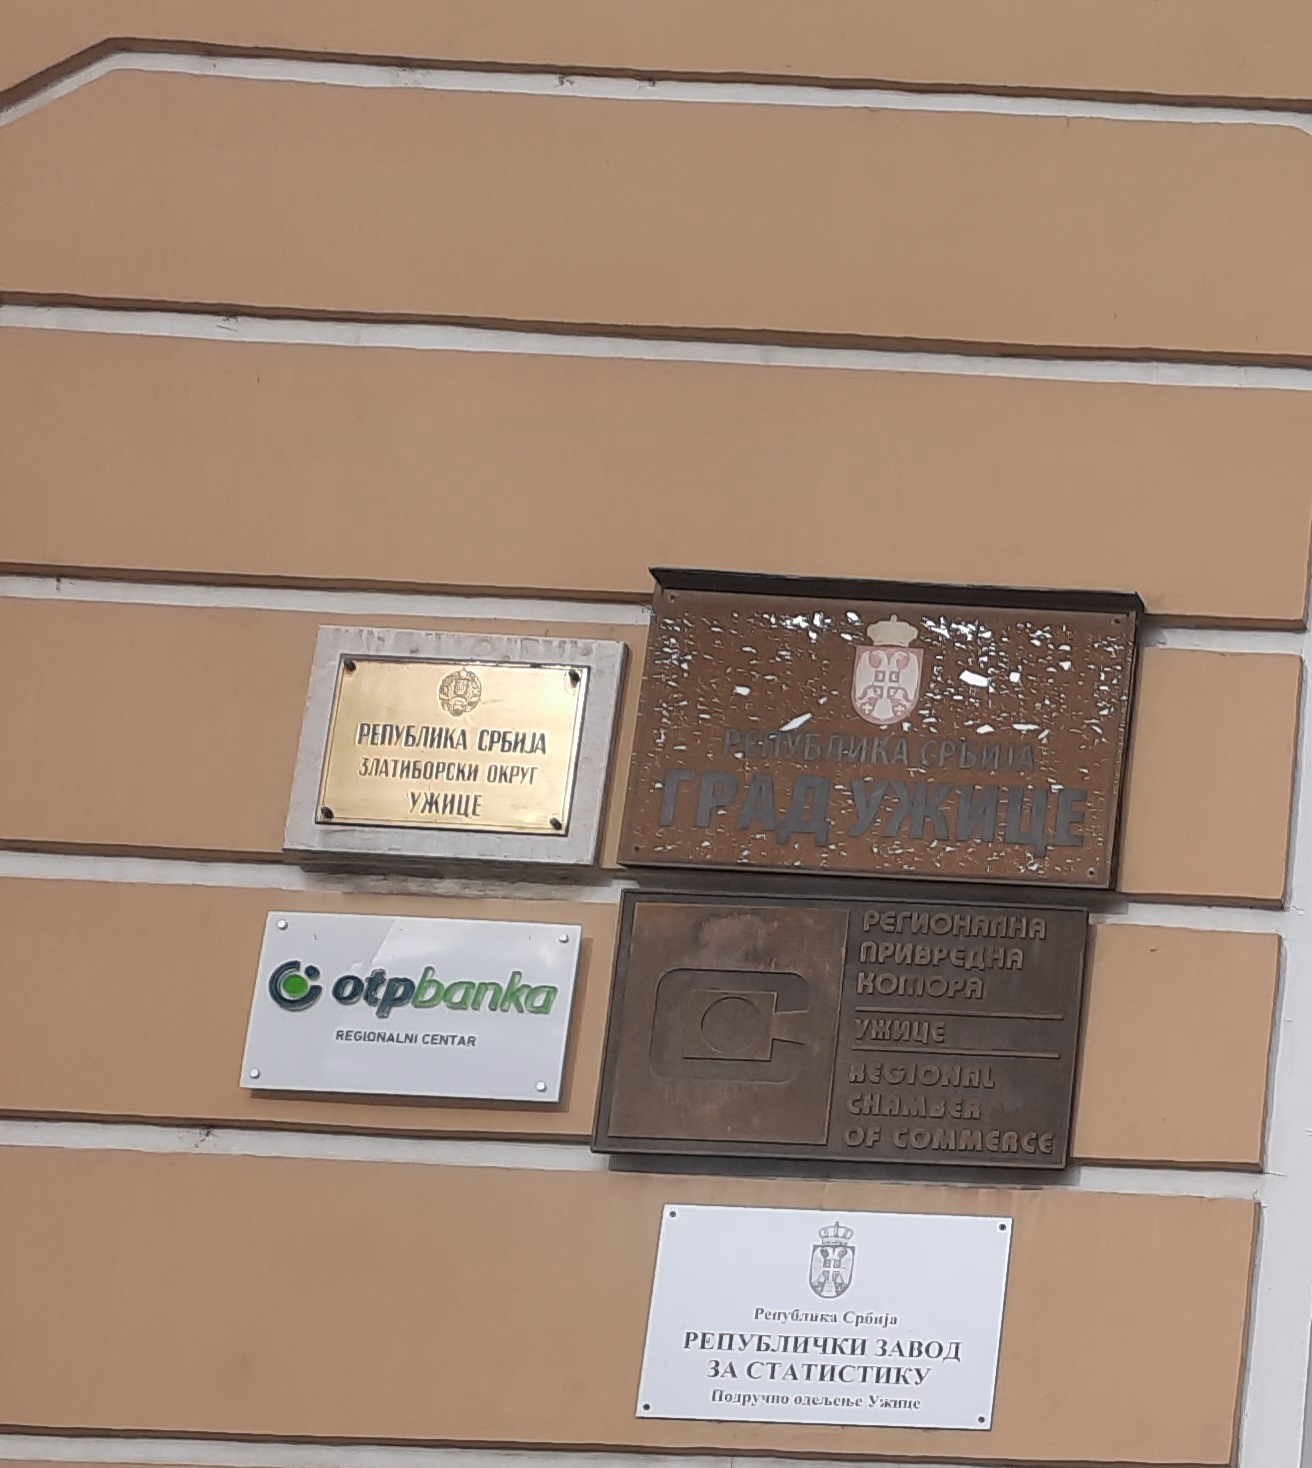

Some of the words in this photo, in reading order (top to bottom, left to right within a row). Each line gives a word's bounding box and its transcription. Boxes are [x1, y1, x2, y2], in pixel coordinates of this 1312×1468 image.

[357, 723, 467, 750] РЕПУБЛИКА
[478, 729, 546, 754] СРБИЈА
[723, 728, 909, 765] РЕПУБЛИКА
[920, 740, 1034, 770] СРБИЈА
[358, 757, 478, 783] ЗЛАТИБОРСКИ
[487, 764, 538, 785] ОКРУГ
[407, 791, 482, 818] УЖИЦЕ
[658, 769, 831, 847] ГРАД
[848, 778, 1089, 858] УЖИЦЕ
[862, 909, 1047, 941] РЕГИОНАЛНА
[859, 941, 1024, 970] ПРИВРЕДНА
[331, 966, 558, 1019] otpbanka
[856, 972, 984, 999] КОМОРА
[335, 1029, 418, 1045] REGIONALNI
[422, 1033, 477, 1047] CENTAR
[853, 1018, 947, 1045] УЖИЦЕ
[848, 1063, 996, 1089] REGIONAL
[845, 1094, 981, 1120] CHAMBER
[843, 1126, 881, 1149] OF
[892, 1128, 1055, 1155] COMMERCE
[753, 1307, 838, 1325] Република
[843, 1310, 898, 1328] Србија
[683, 1331, 867, 1357] РЕПУБЛИЧКИ
[874, 1338, 963, 1363] ЗАВОД
[706, 1359, 738, 1379] ЗА
[746, 1361, 931, 1386] СТАТИСТИКУ
